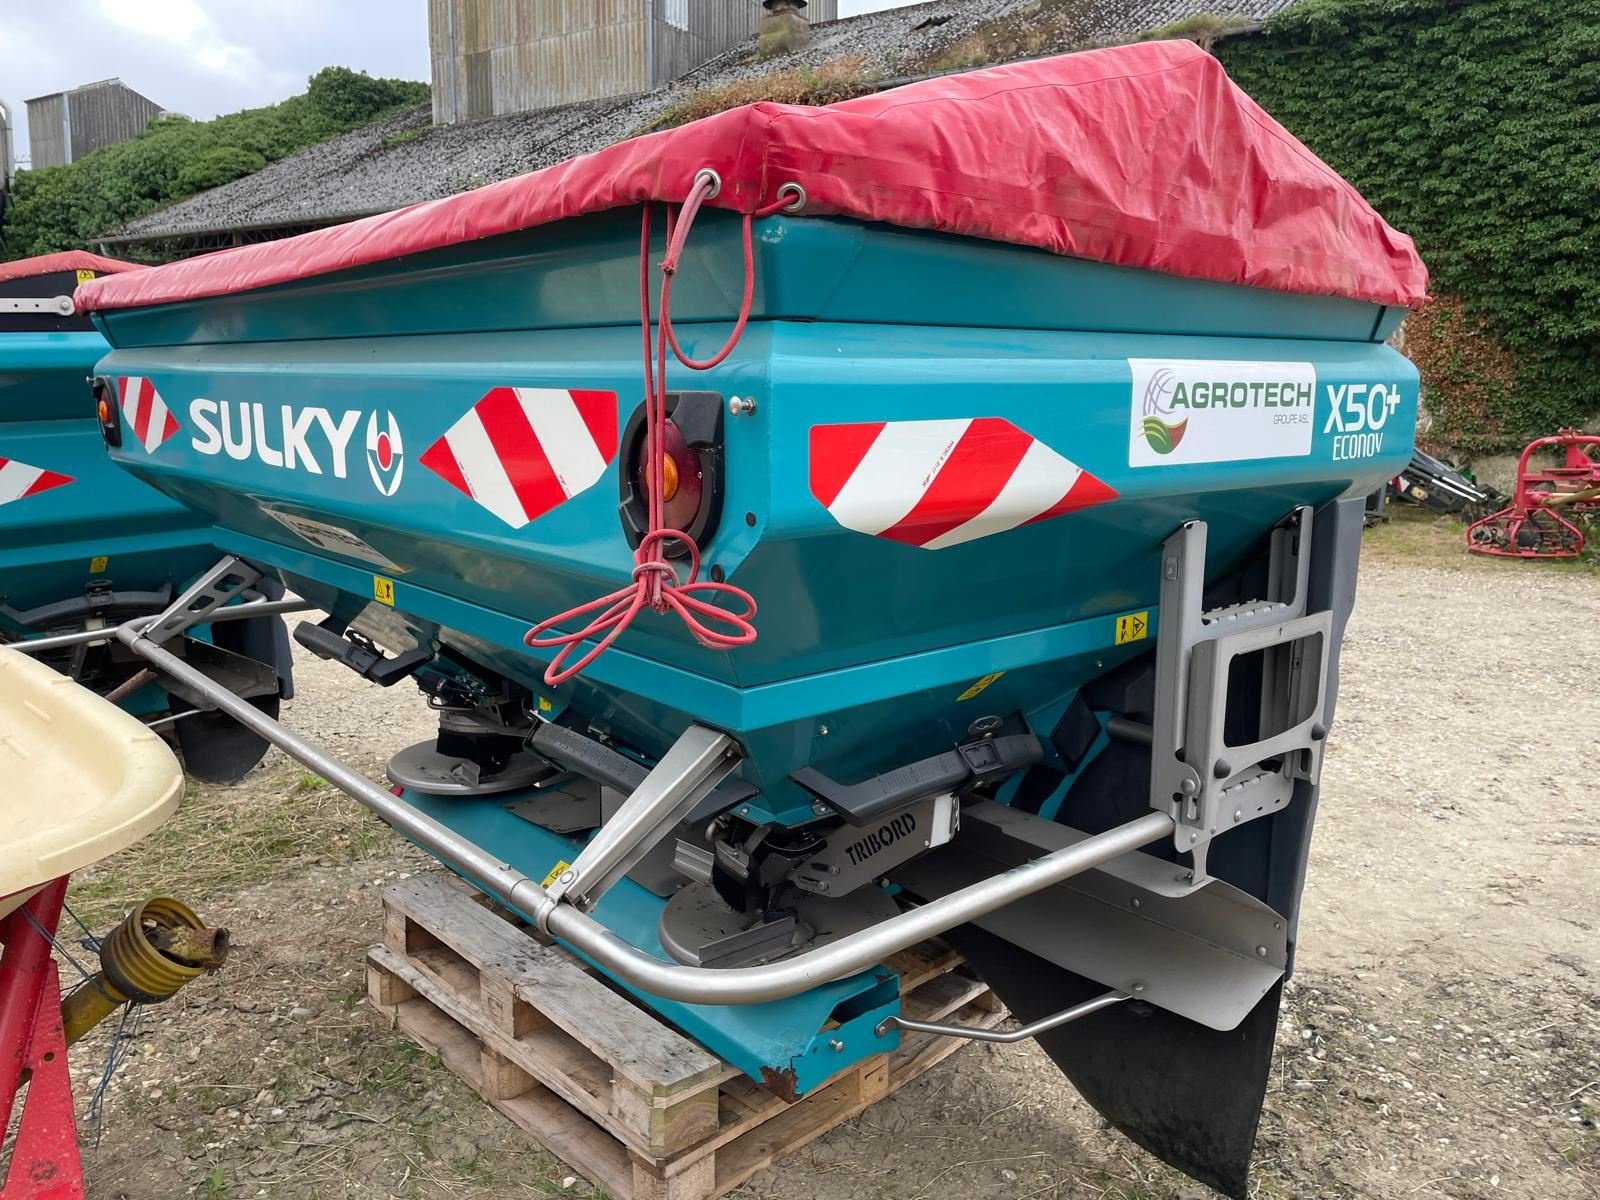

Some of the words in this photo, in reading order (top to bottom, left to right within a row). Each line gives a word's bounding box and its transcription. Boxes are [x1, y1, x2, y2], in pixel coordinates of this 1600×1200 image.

[1169, 382, 1312, 409] AGROTECH
[1323, 383, 1401, 434] X50+
[189, 398, 362, 479] SULKY
[1273, 414, 1298, 424] GROUPE
[1299, 414, 1309, 424] ASL
[1332, 433, 1384, 461] ECONOV
[845, 813, 916, 866] TRIBORD
